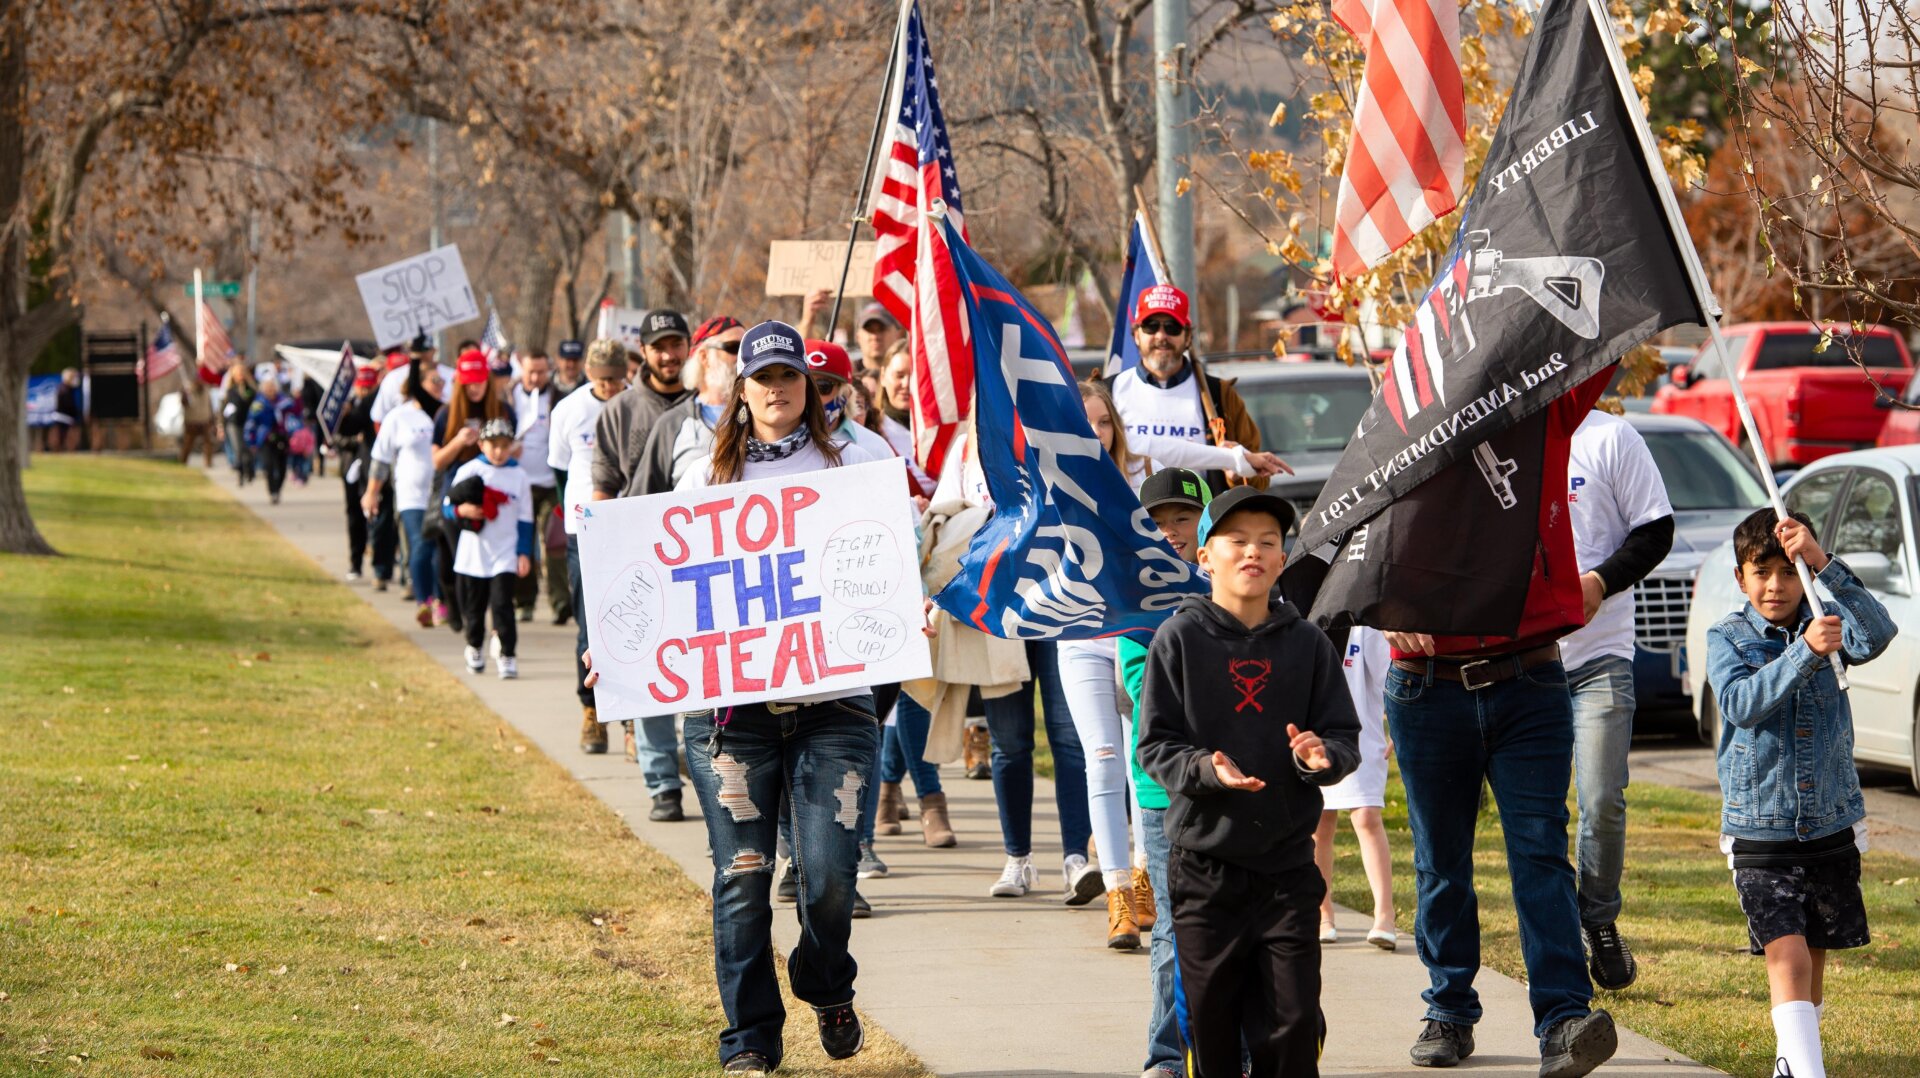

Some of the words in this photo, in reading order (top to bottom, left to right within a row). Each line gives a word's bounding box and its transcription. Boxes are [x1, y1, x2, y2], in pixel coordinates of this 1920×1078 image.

[382, 255, 446, 305] STOP
[781, 267, 815, 289] THE
[830, 266, 873, 294] VOT
[1144, 293, 1181, 304] AMERICA
[1148, 300, 1175, 309] GREAT
[752, 334, 793, 349] TRUMP
[1125, 424, 1200, 437] TRUMP
[654, 486, 820, 566] STOP
[823, 534, 884, 557] FIGHT
[672, 550, 821, 632] THE
[833, 579, 887, 598] FRAUD!
[600, 569, 654, 633] TRUMP
[846, 614, 897, 640] STAND
[648, 621, 865, 703] STEAL
[857, 639, 886, 661] UP!
